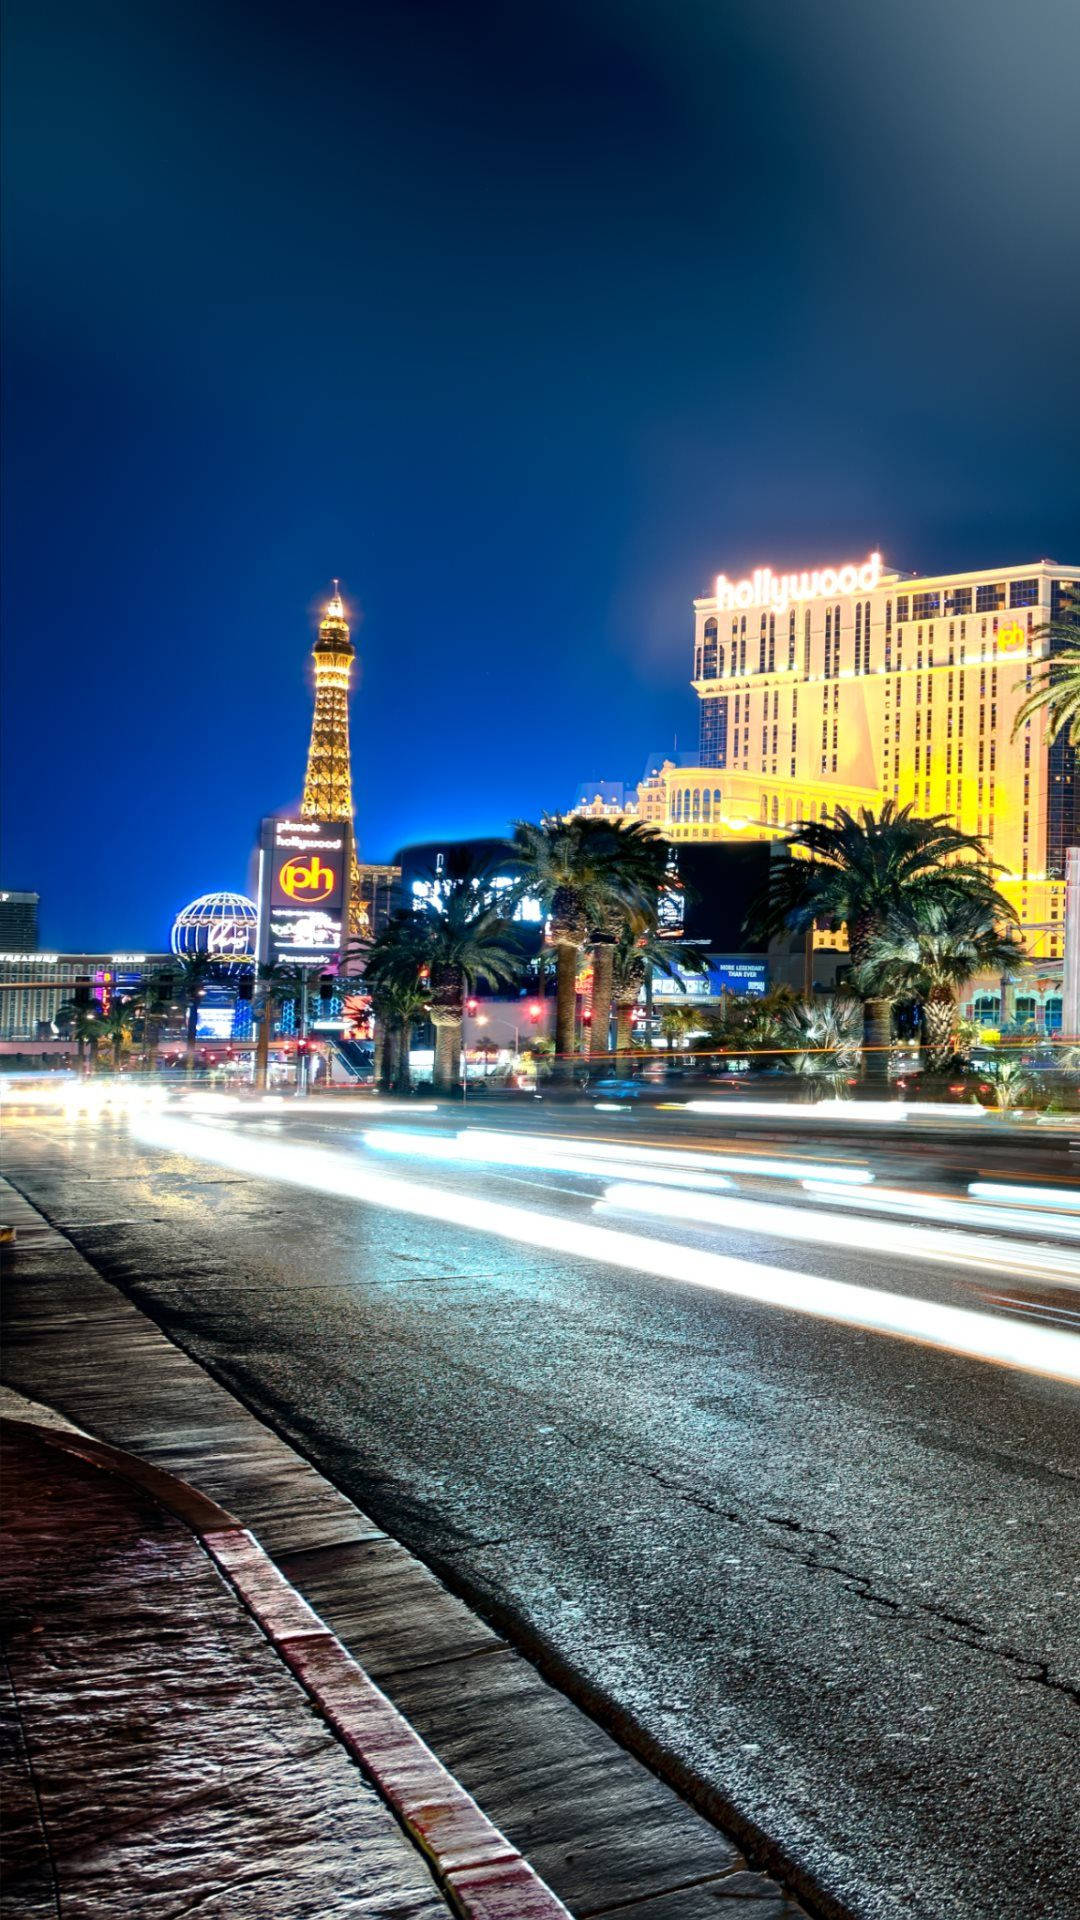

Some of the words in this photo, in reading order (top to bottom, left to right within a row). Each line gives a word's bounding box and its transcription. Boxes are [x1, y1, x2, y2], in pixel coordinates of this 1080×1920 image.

[716, 552, 882, 615] hollywood
[276, 819, 321, 834] planet
[276, 835, 342, 849] hollywood
[286, 856, 334, 897] ph
[728, 970, 742, 978] THAN
